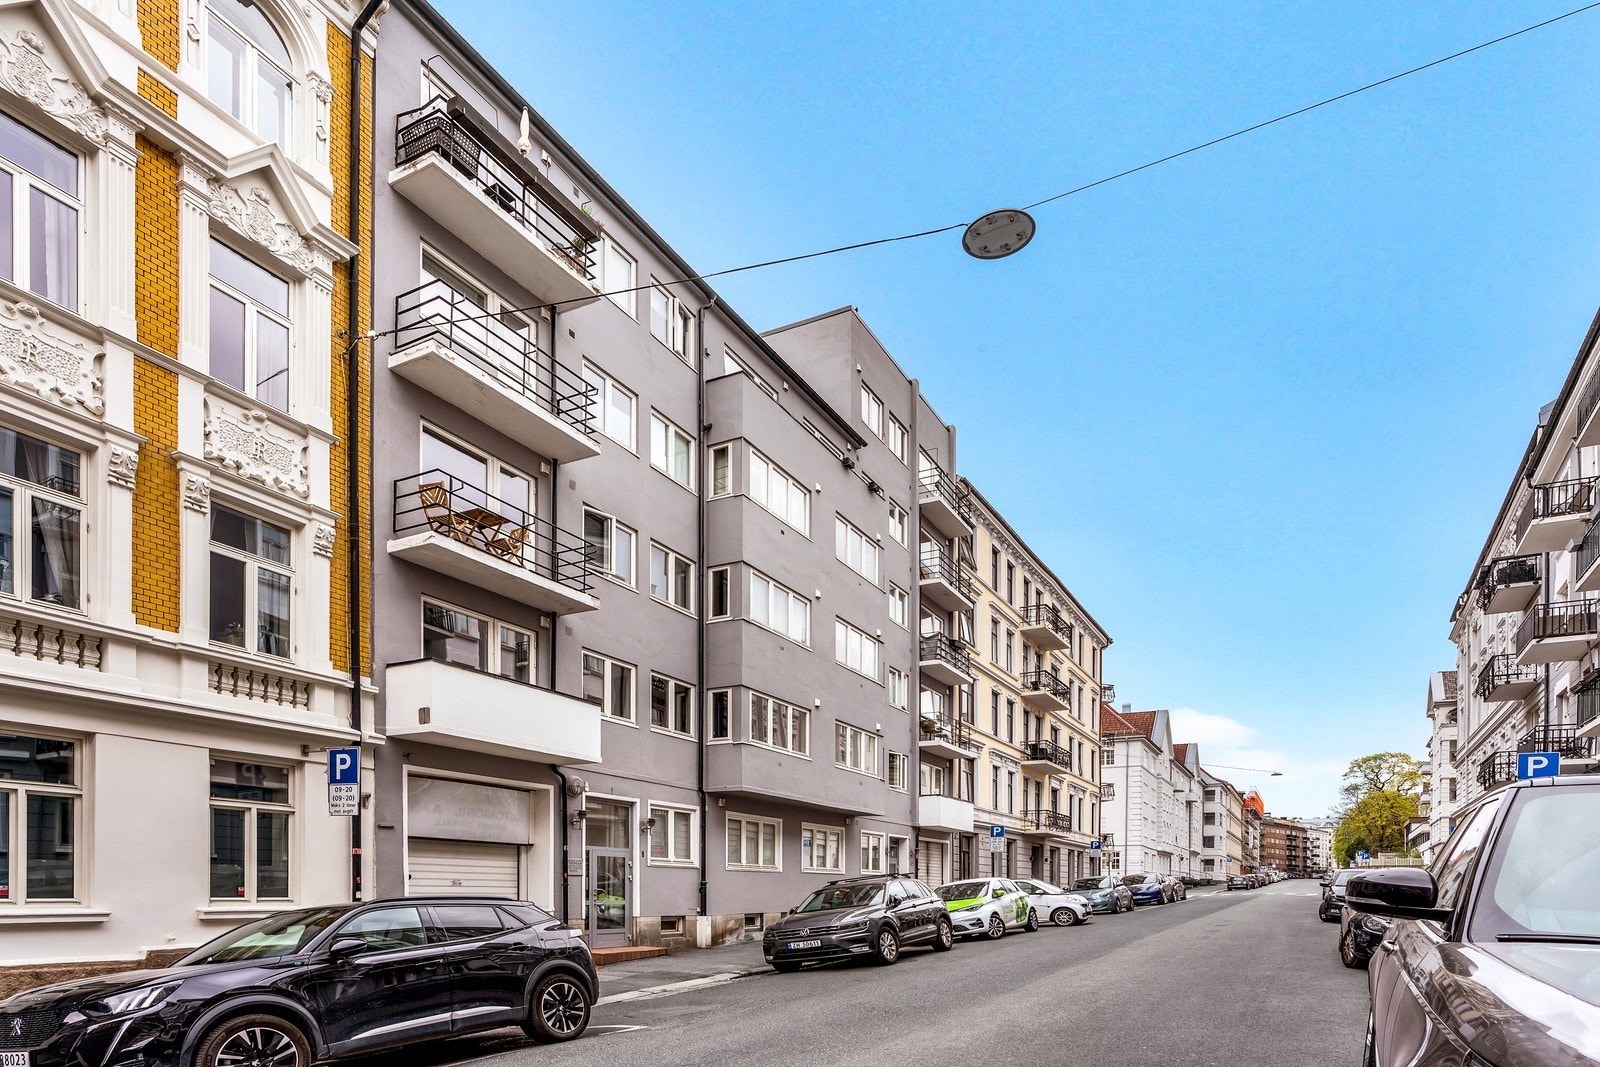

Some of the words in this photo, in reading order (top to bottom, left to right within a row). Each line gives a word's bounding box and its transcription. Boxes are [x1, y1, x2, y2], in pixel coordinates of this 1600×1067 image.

[336, 754, 351, 780] P
[1527, 756, 1549, 777] P
[332, 794, 355, 802] (09-20)
[993, 827, 1002, 836] P
[1092, 841, 1099, 849] P
